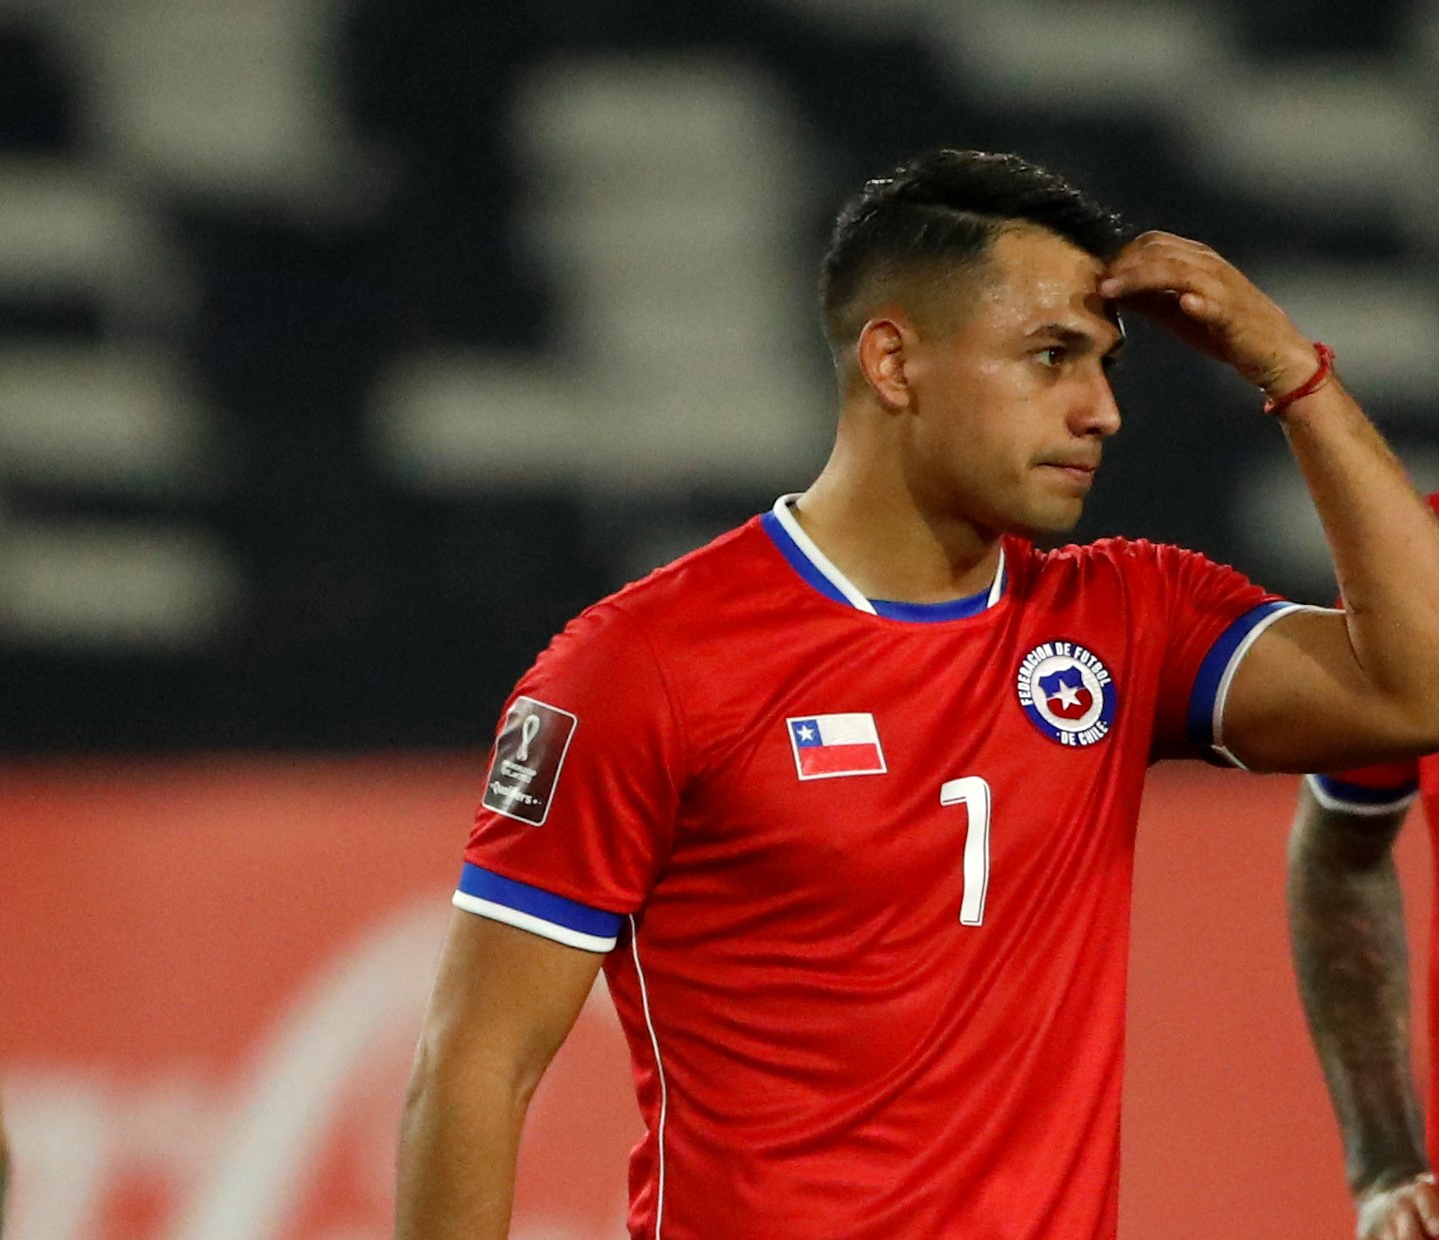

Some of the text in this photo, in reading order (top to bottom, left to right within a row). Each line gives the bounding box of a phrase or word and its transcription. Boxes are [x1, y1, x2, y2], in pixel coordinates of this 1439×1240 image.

[1017, 641, 1112, 706] FEDERACION DE FUTBOL
[1060, 721, 1109, 746] DE CHILE
[939, 775, 992, 927] 7
